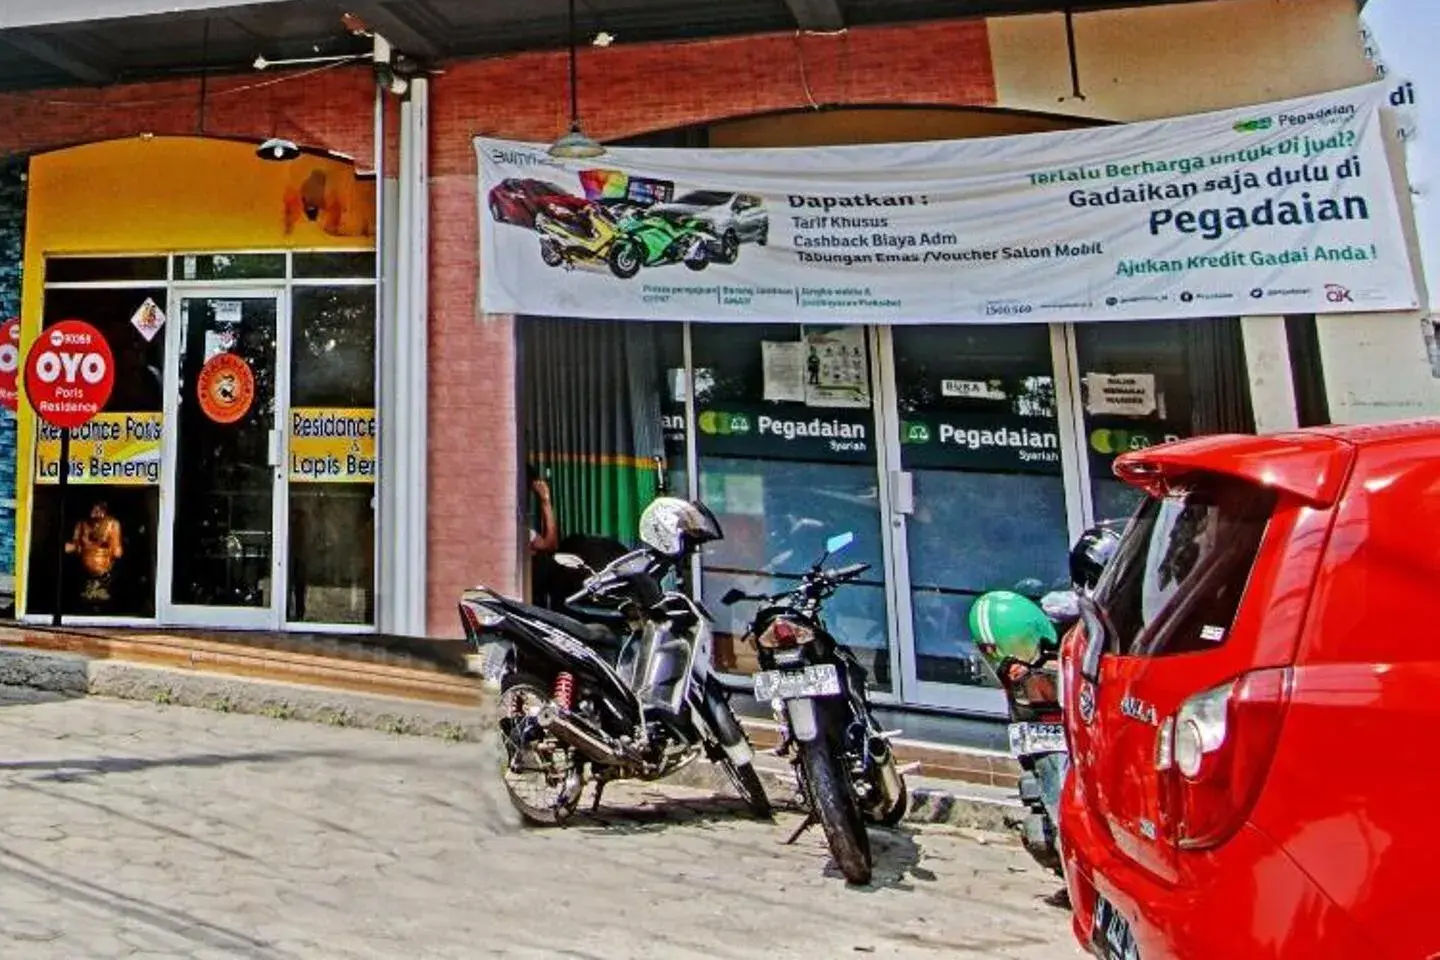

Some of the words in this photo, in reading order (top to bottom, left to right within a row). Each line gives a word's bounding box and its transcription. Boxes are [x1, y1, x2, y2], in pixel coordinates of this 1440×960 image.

[1390, 82, 1414, 106] di
[1278, 104, 1355, 127] Pegadaian
[1029, 167, 1100, 185] Terlalu
[1106, 156, 1204, 178] Berharga
[1211, 143, 1274, 165] untuk
[1069, 180, 1198, 207] Gadaikan
[1204, 170, 1260, 195] saja
[1267, 164, 1329, 187] dulu
[1336, 155, 1361, 179] di
[788, 194, 915, 212] Dapatkan
[792, 216, 827, 229] Tarif
[831, 217, 888, 228] Khusus
[1149, 192, 1369, 240] Pegadaian
[794, 234, 869, 247] Cashback
[872, 233, 916, 249] Biaya
[919, 232, 957, 246] Adm
[796, 251, 872, 265] Tabungan
[875, 252, 919, 262] Emas
[1001, 245, 1051, 260] Salon
[1055, 242, 1104, 258] Mobil
[1116, 259, 1183, 277] Ajukan
[1187, 251, 1249, 269] Kredit
[1250, 247, 1309, 266] Gadai
[1315, 243, 1367, 261] Anda
[36, 351, 106, 384] OYO
[758, 416, 865, 439] Pegadaian
[939, 424, 1057, 449] Pegadaian
[90, 458, 158, 481] Beneng
[293, 451, 340, 478] Lapis
